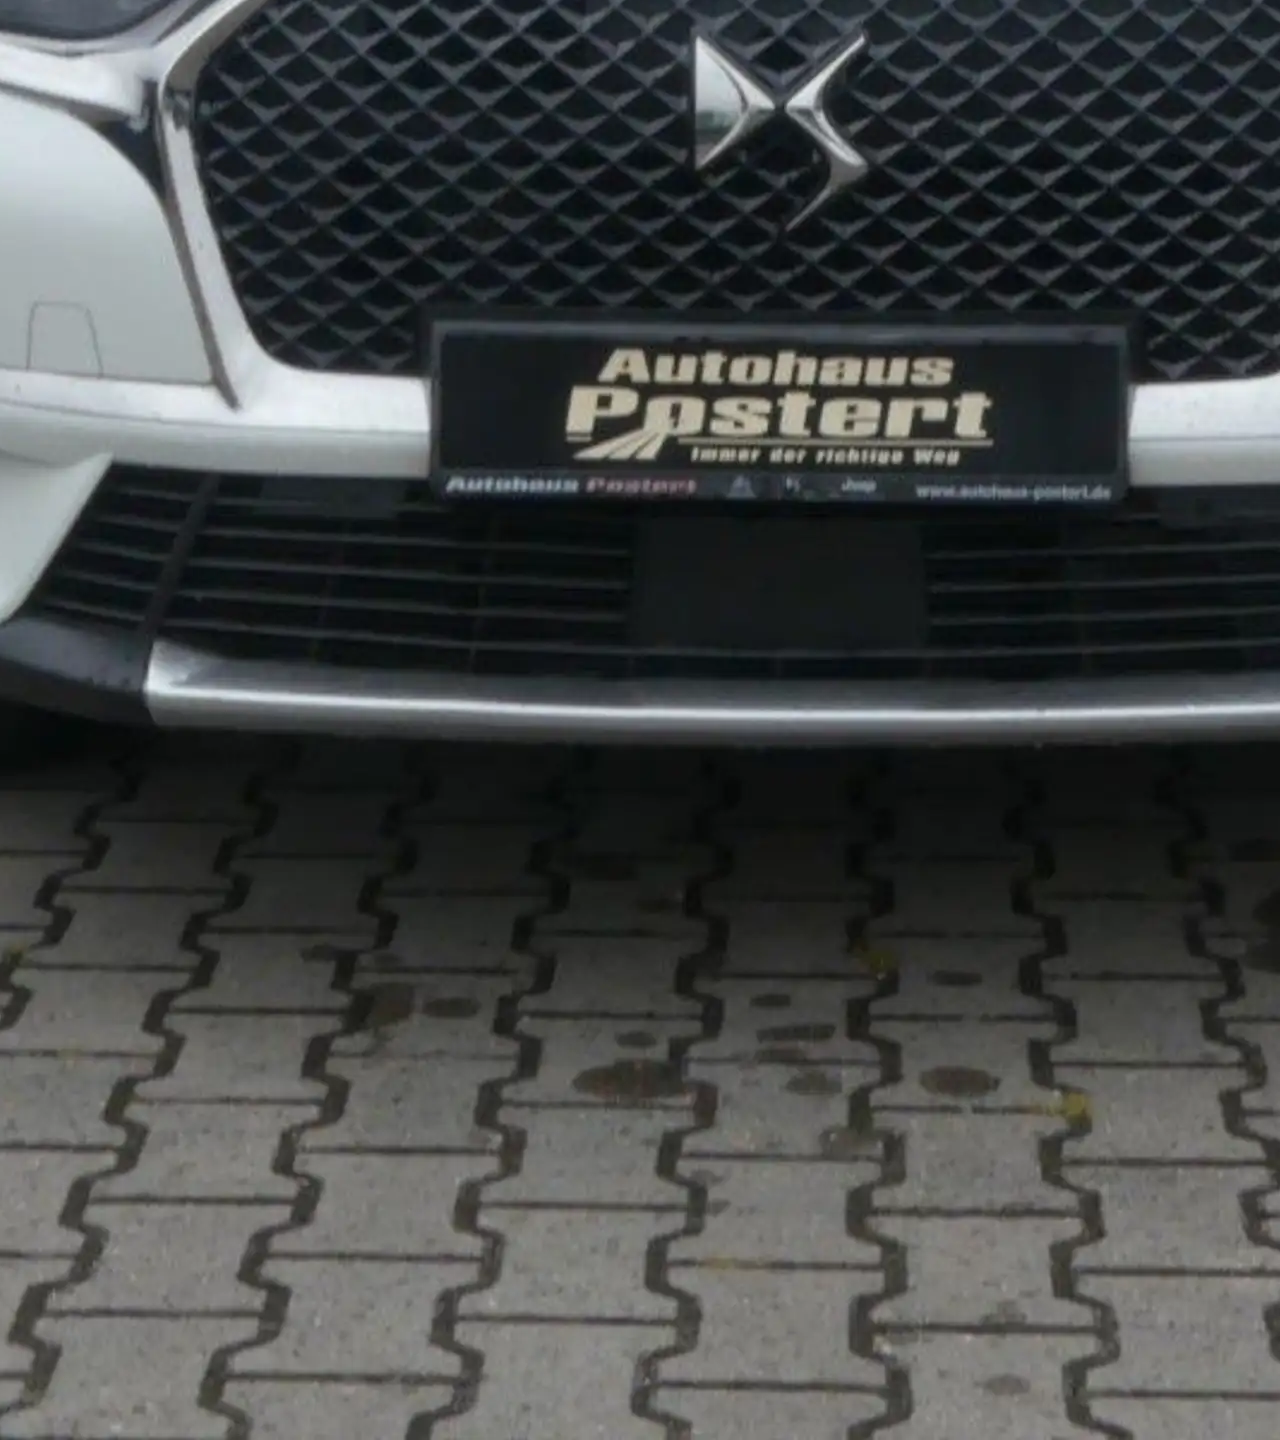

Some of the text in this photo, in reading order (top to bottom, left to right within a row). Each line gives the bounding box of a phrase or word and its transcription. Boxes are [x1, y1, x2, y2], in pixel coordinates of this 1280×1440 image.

[597, 347, 955, 387] Autohaus
[565, 385, 993, 442] Postert
[690, 446, 761, 463] Immer
[770, 446, 807, 464] der
[914, 447, 961, 467] Weg
[445, 474, 697, 495] Autohaus Postert
